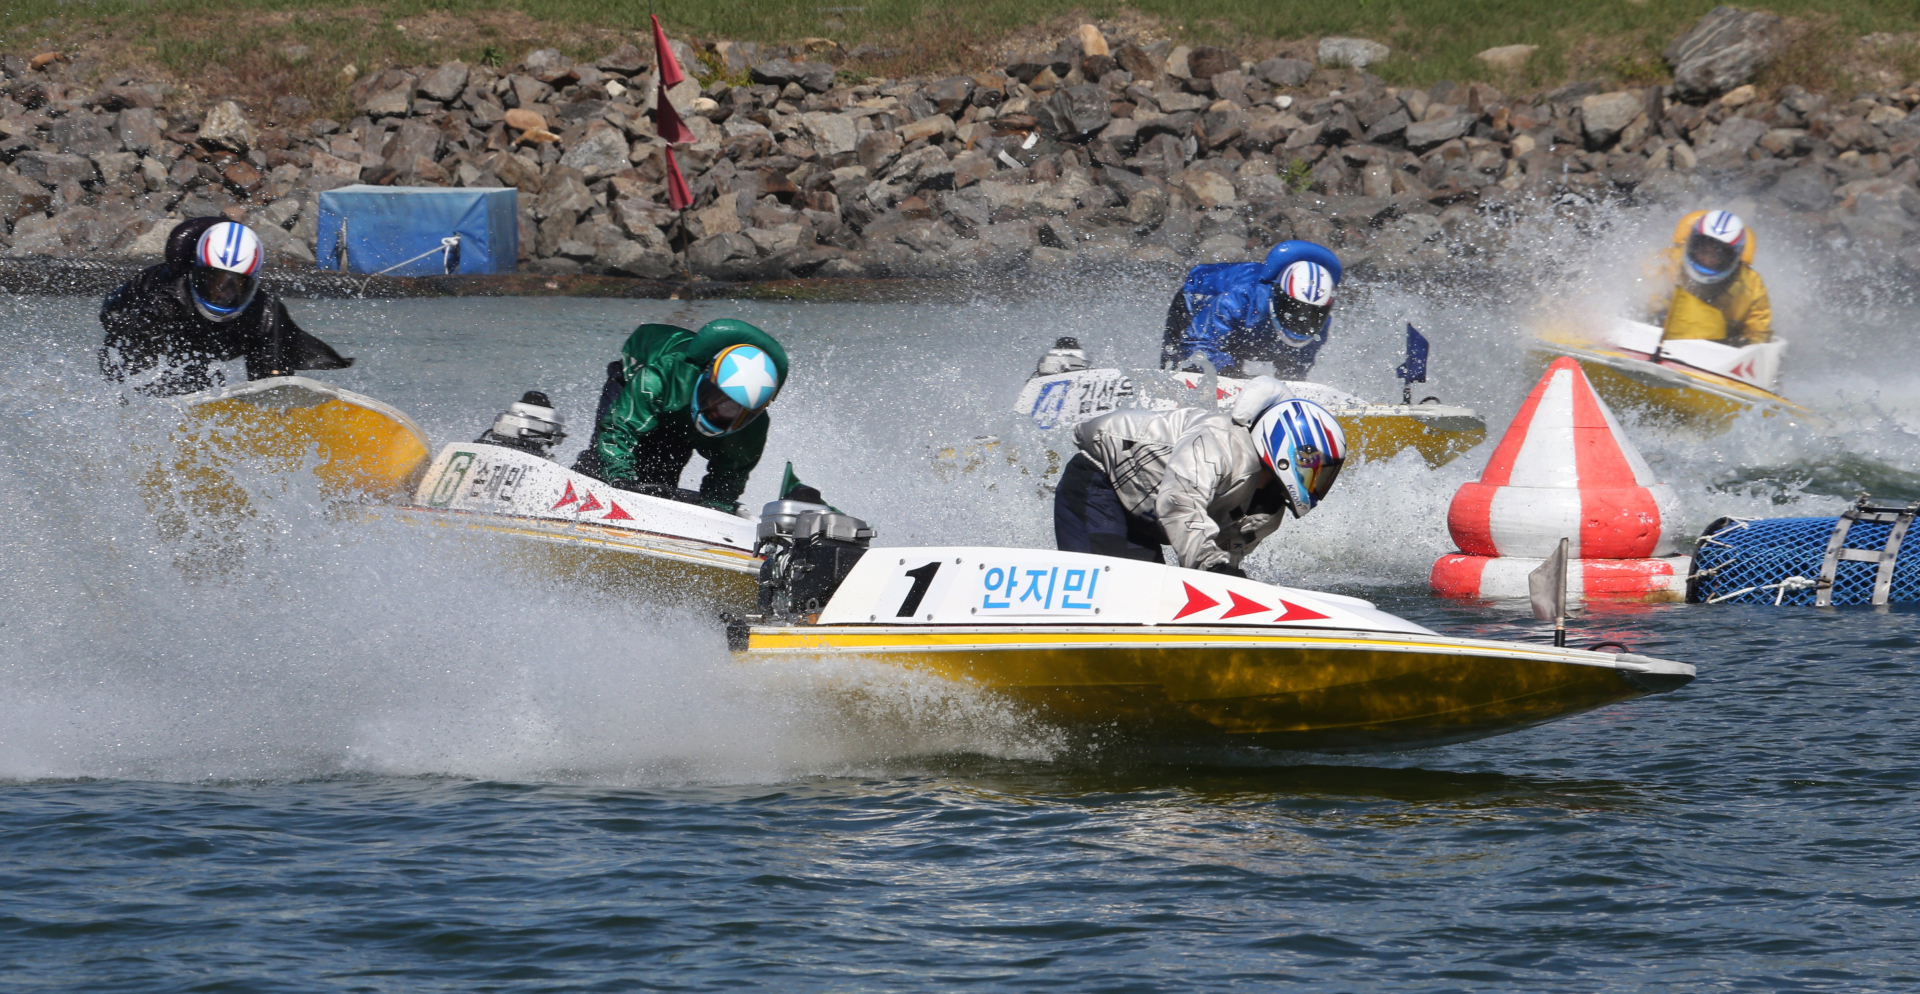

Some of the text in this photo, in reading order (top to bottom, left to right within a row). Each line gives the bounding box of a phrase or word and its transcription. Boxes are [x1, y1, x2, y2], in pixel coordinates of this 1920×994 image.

[430, 452, 475, 506] 6
[895, 562, 942, 617] 1
[983, 566, 1100, 610] 안지민
